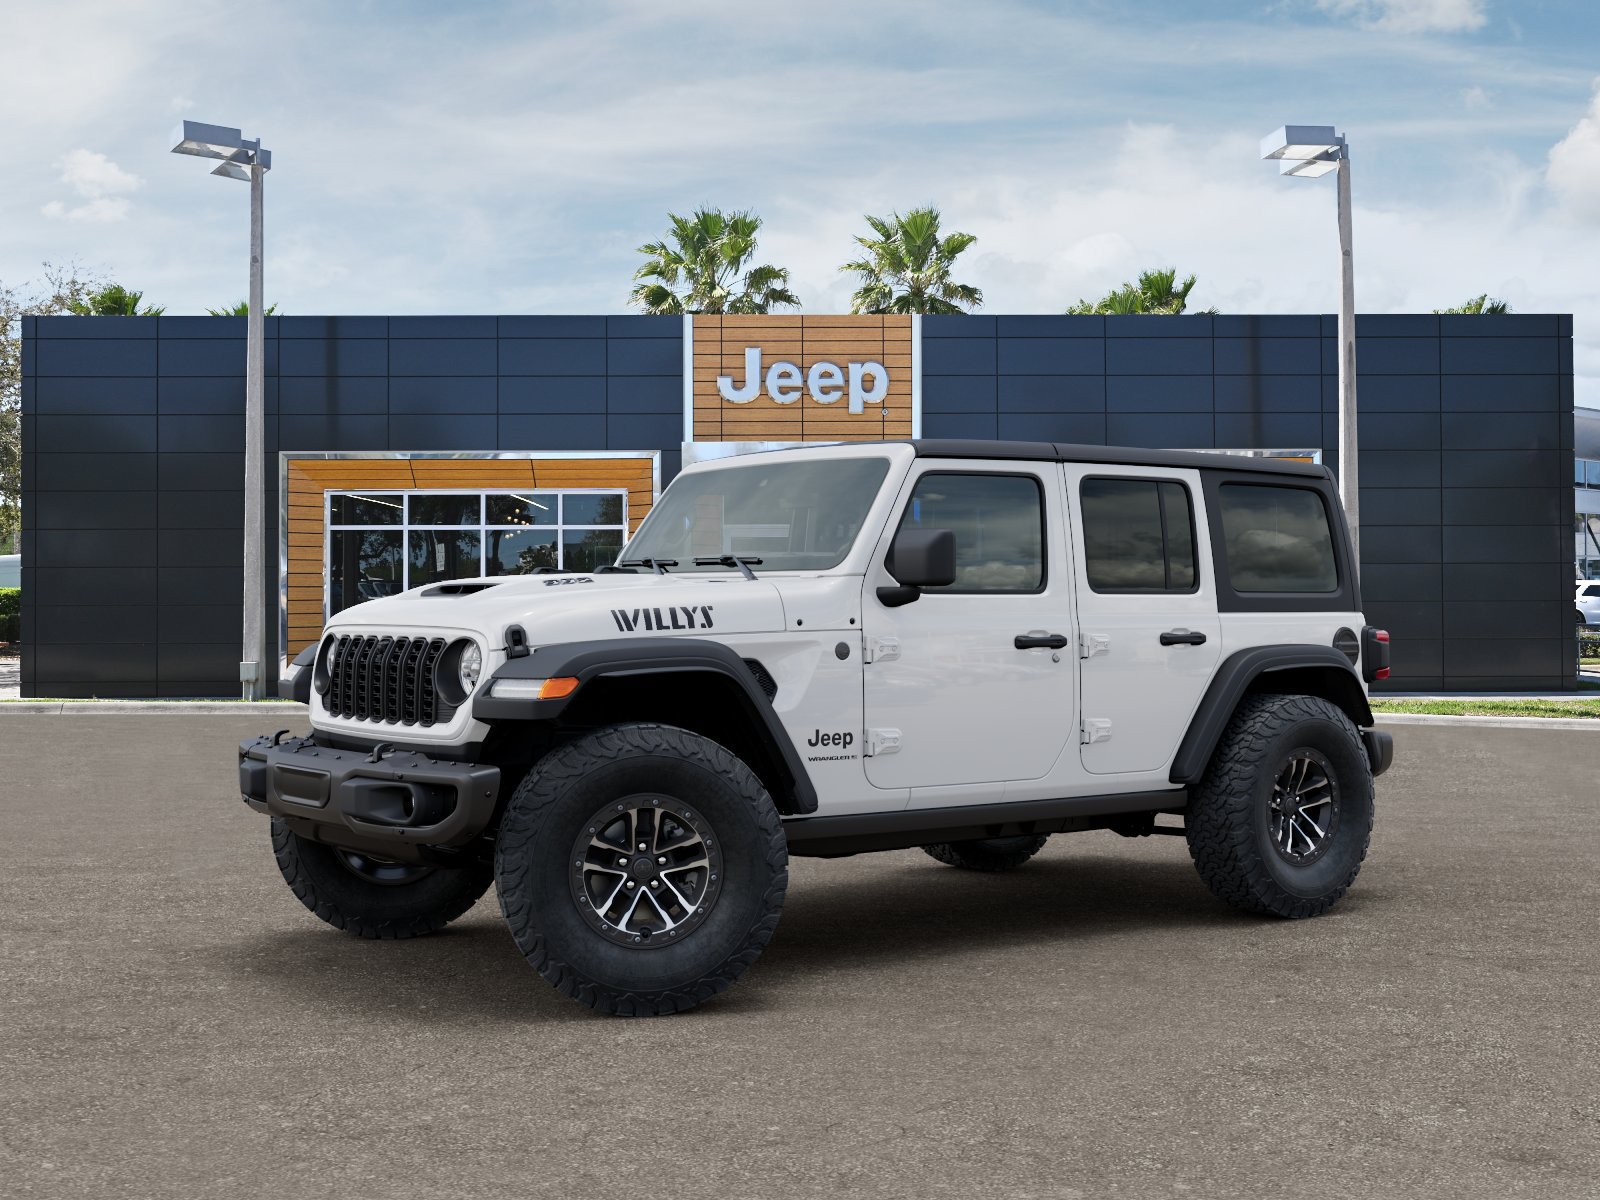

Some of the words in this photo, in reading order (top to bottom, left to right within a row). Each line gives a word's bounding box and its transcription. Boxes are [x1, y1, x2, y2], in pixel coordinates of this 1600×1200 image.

[716, 347, 889, 414] Jeep
[610, 606, 714, 632] WILLYS
[807, 729, 853, 749] Jeep
